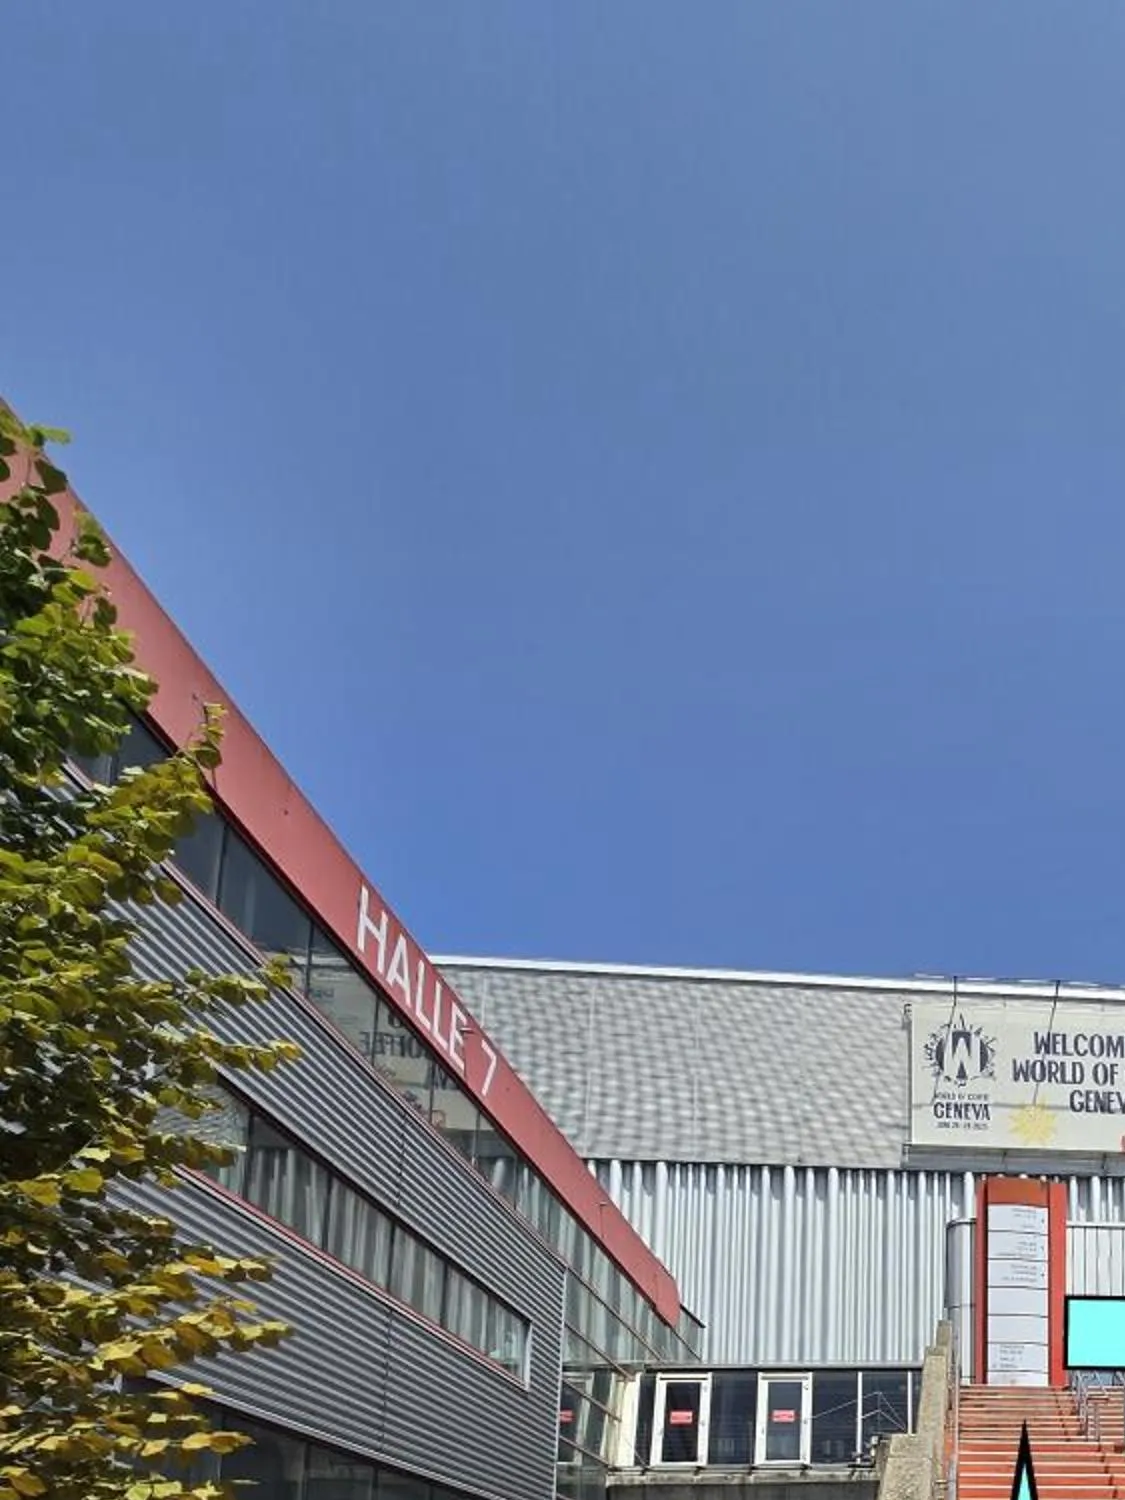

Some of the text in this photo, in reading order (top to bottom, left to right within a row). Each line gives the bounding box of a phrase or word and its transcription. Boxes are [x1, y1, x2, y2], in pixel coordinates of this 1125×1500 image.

[357, 884, 467, 1071] HALLE
[480, 1040, 498, 1096] 7
[1012, 1059, 1085, 1086] WORLD
[1092, 1062, 1119, 1086] OF
[933, 1101, 991, 1121] GENEVA
